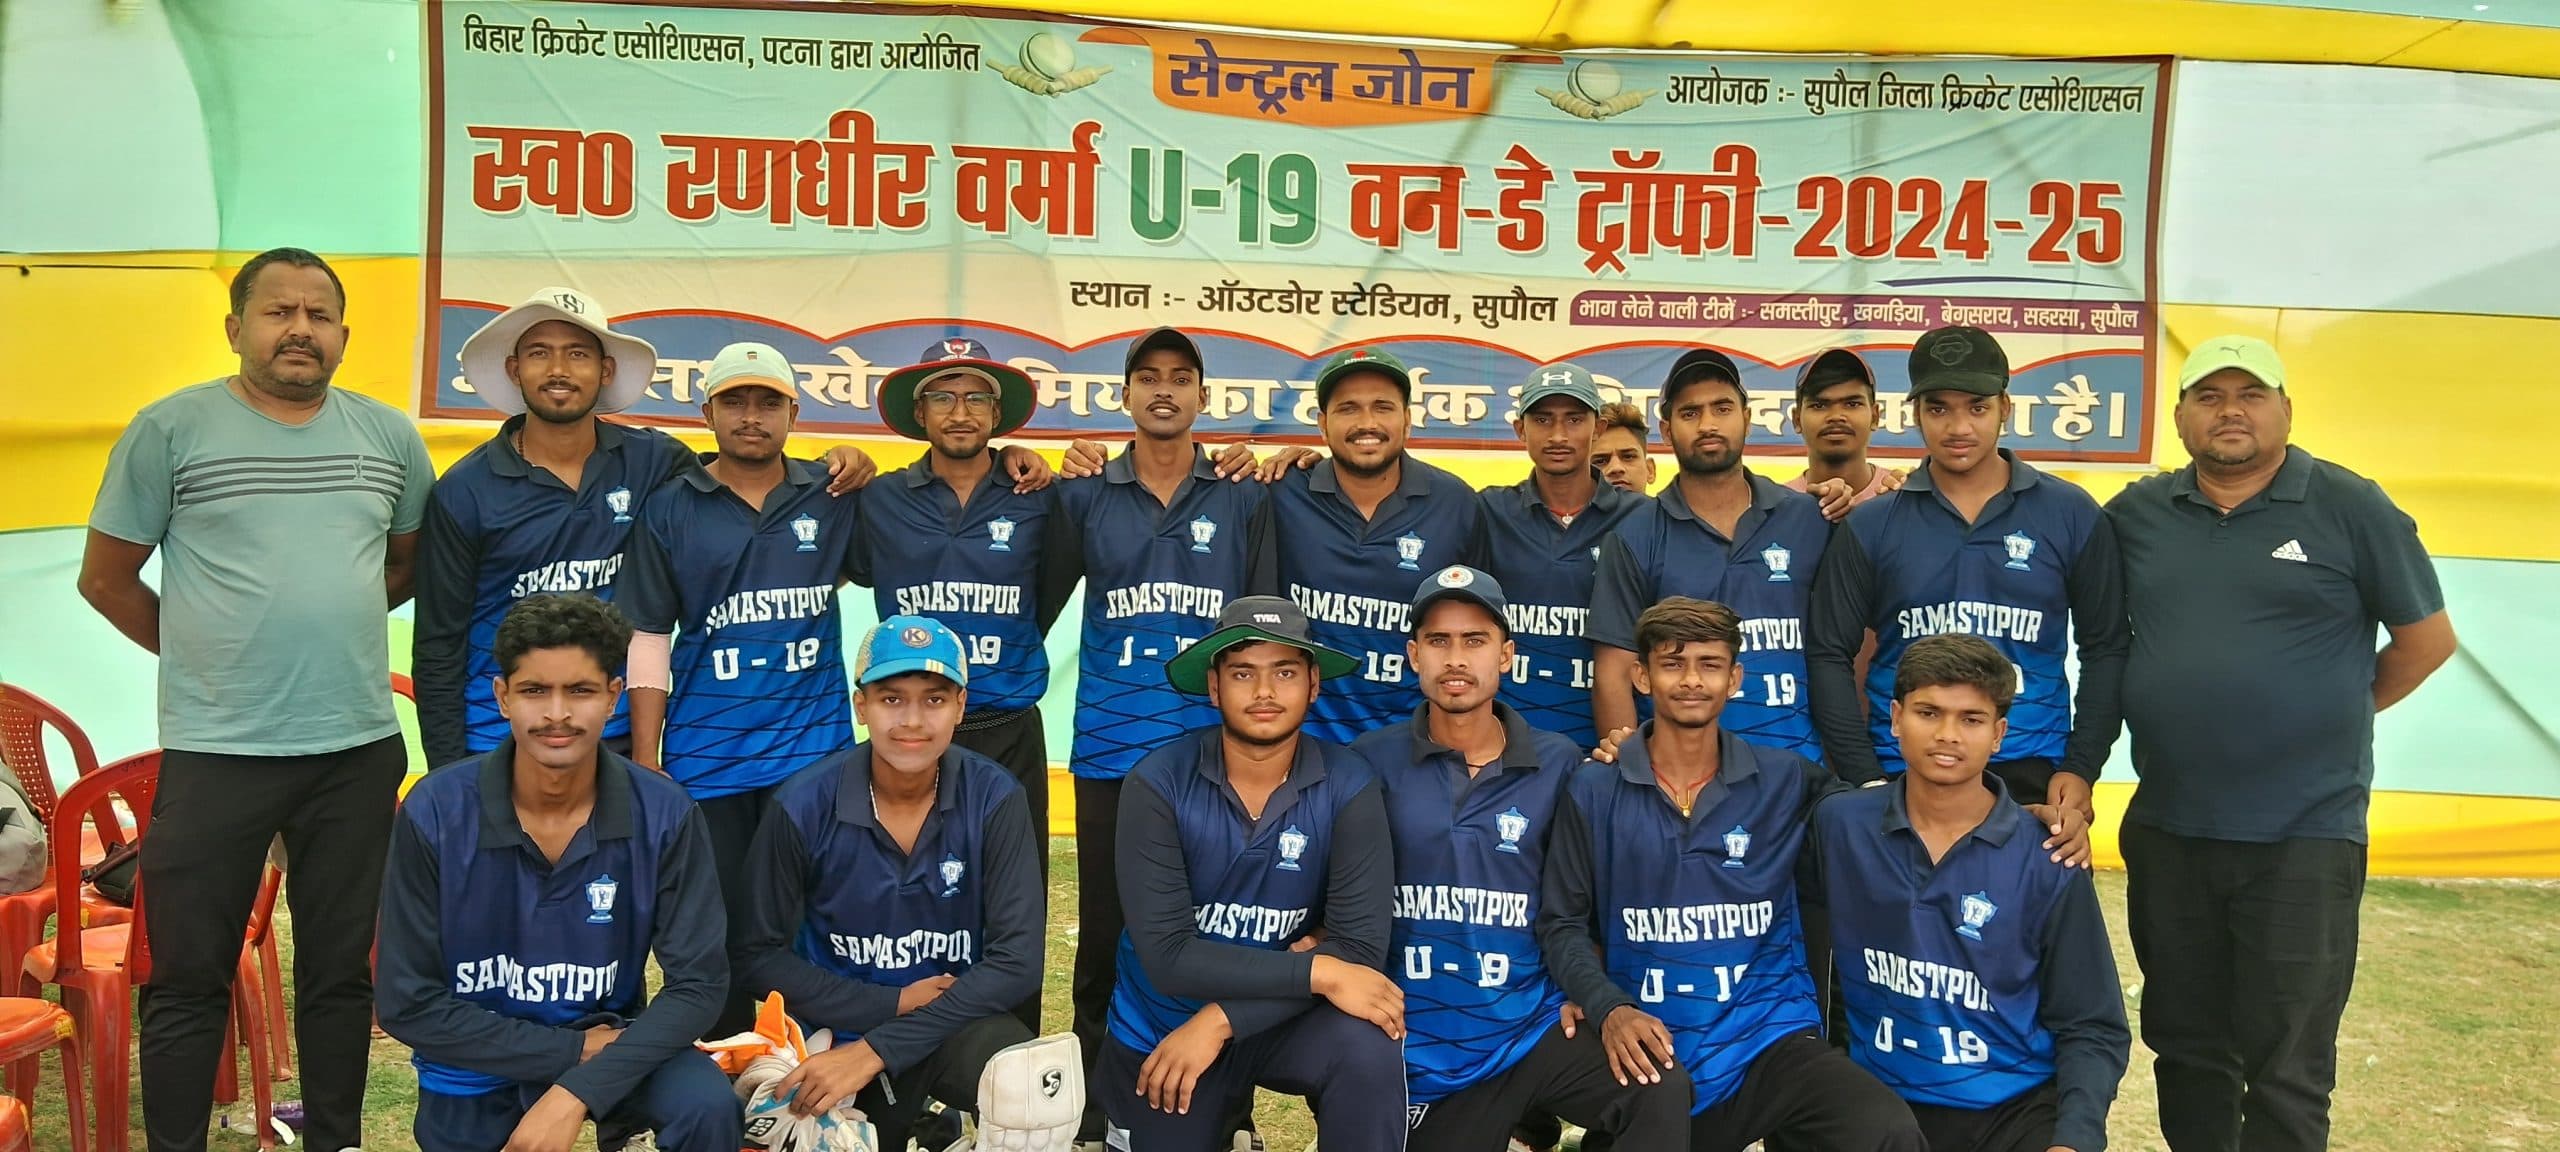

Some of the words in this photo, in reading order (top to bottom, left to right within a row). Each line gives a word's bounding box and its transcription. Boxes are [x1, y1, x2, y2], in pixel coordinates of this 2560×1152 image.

[463, 13, 525, 53] बिहार
[531, 17, 607, 59] क्रिकेट
[613, 21, 754, 69] एसोशिएसन,
[761, 36, 822, 67] पटना
[829, 39, 873, 70] द्वारा
[880, 32, 981, 72] आयोजित
[1168, 39, 1337, 115] सेन्ट्रल
[1351, 48, 1475, 109] जोन
[1666, 66, 1770, 105] आयोजक
[1804, 68, 1871, 115] सुपौल
[1878, 71, 1935, 109] जिला
[1941, 73, 2015, 113] क्रिकेट
[2019, 76, 2145, 113] एसोशिएसन
[659, 109, 936, 229] रणधीर
[950, 120, 1104, 238] वर्मा
[1129, 147, 1319, 246] U-19
[1345, 144, 1555, 253] वन-डे
[1070, 281, 1151, 310] स्थान
[1330, 282, 1462, 324] स्टेडियम,
[1472, 285, 1558, 329] सुपौल
[1579, 298, 1617, 319] भाग
[1622, 294, 1654, 319] लेने
[1659, 296, 1698, 320] वाली
[1703, 296, 1737, 320] टीमें
[2024, 306, 2085, 330] सहरसा,
[2090, 302, 2139, 333] सुपौल
[1290, 583, 1412, 633] SAMASTIPU
[1898, 601, 2043, 643] SAMASTIPUR
[712, 648, 739, 680] U
[785, 637, 820, 672] 19
[969, 634, 1001, 665] 19
[1364, 650, 1404, 682] 19
[1512, 654, 1530, 684] U
[1763, 673, 1796, 706] 19
[1404, 946, 1432, 980] U
[1476, 951, 1509, 988] 19
[1938, 1026, 1989, 1064] 19
